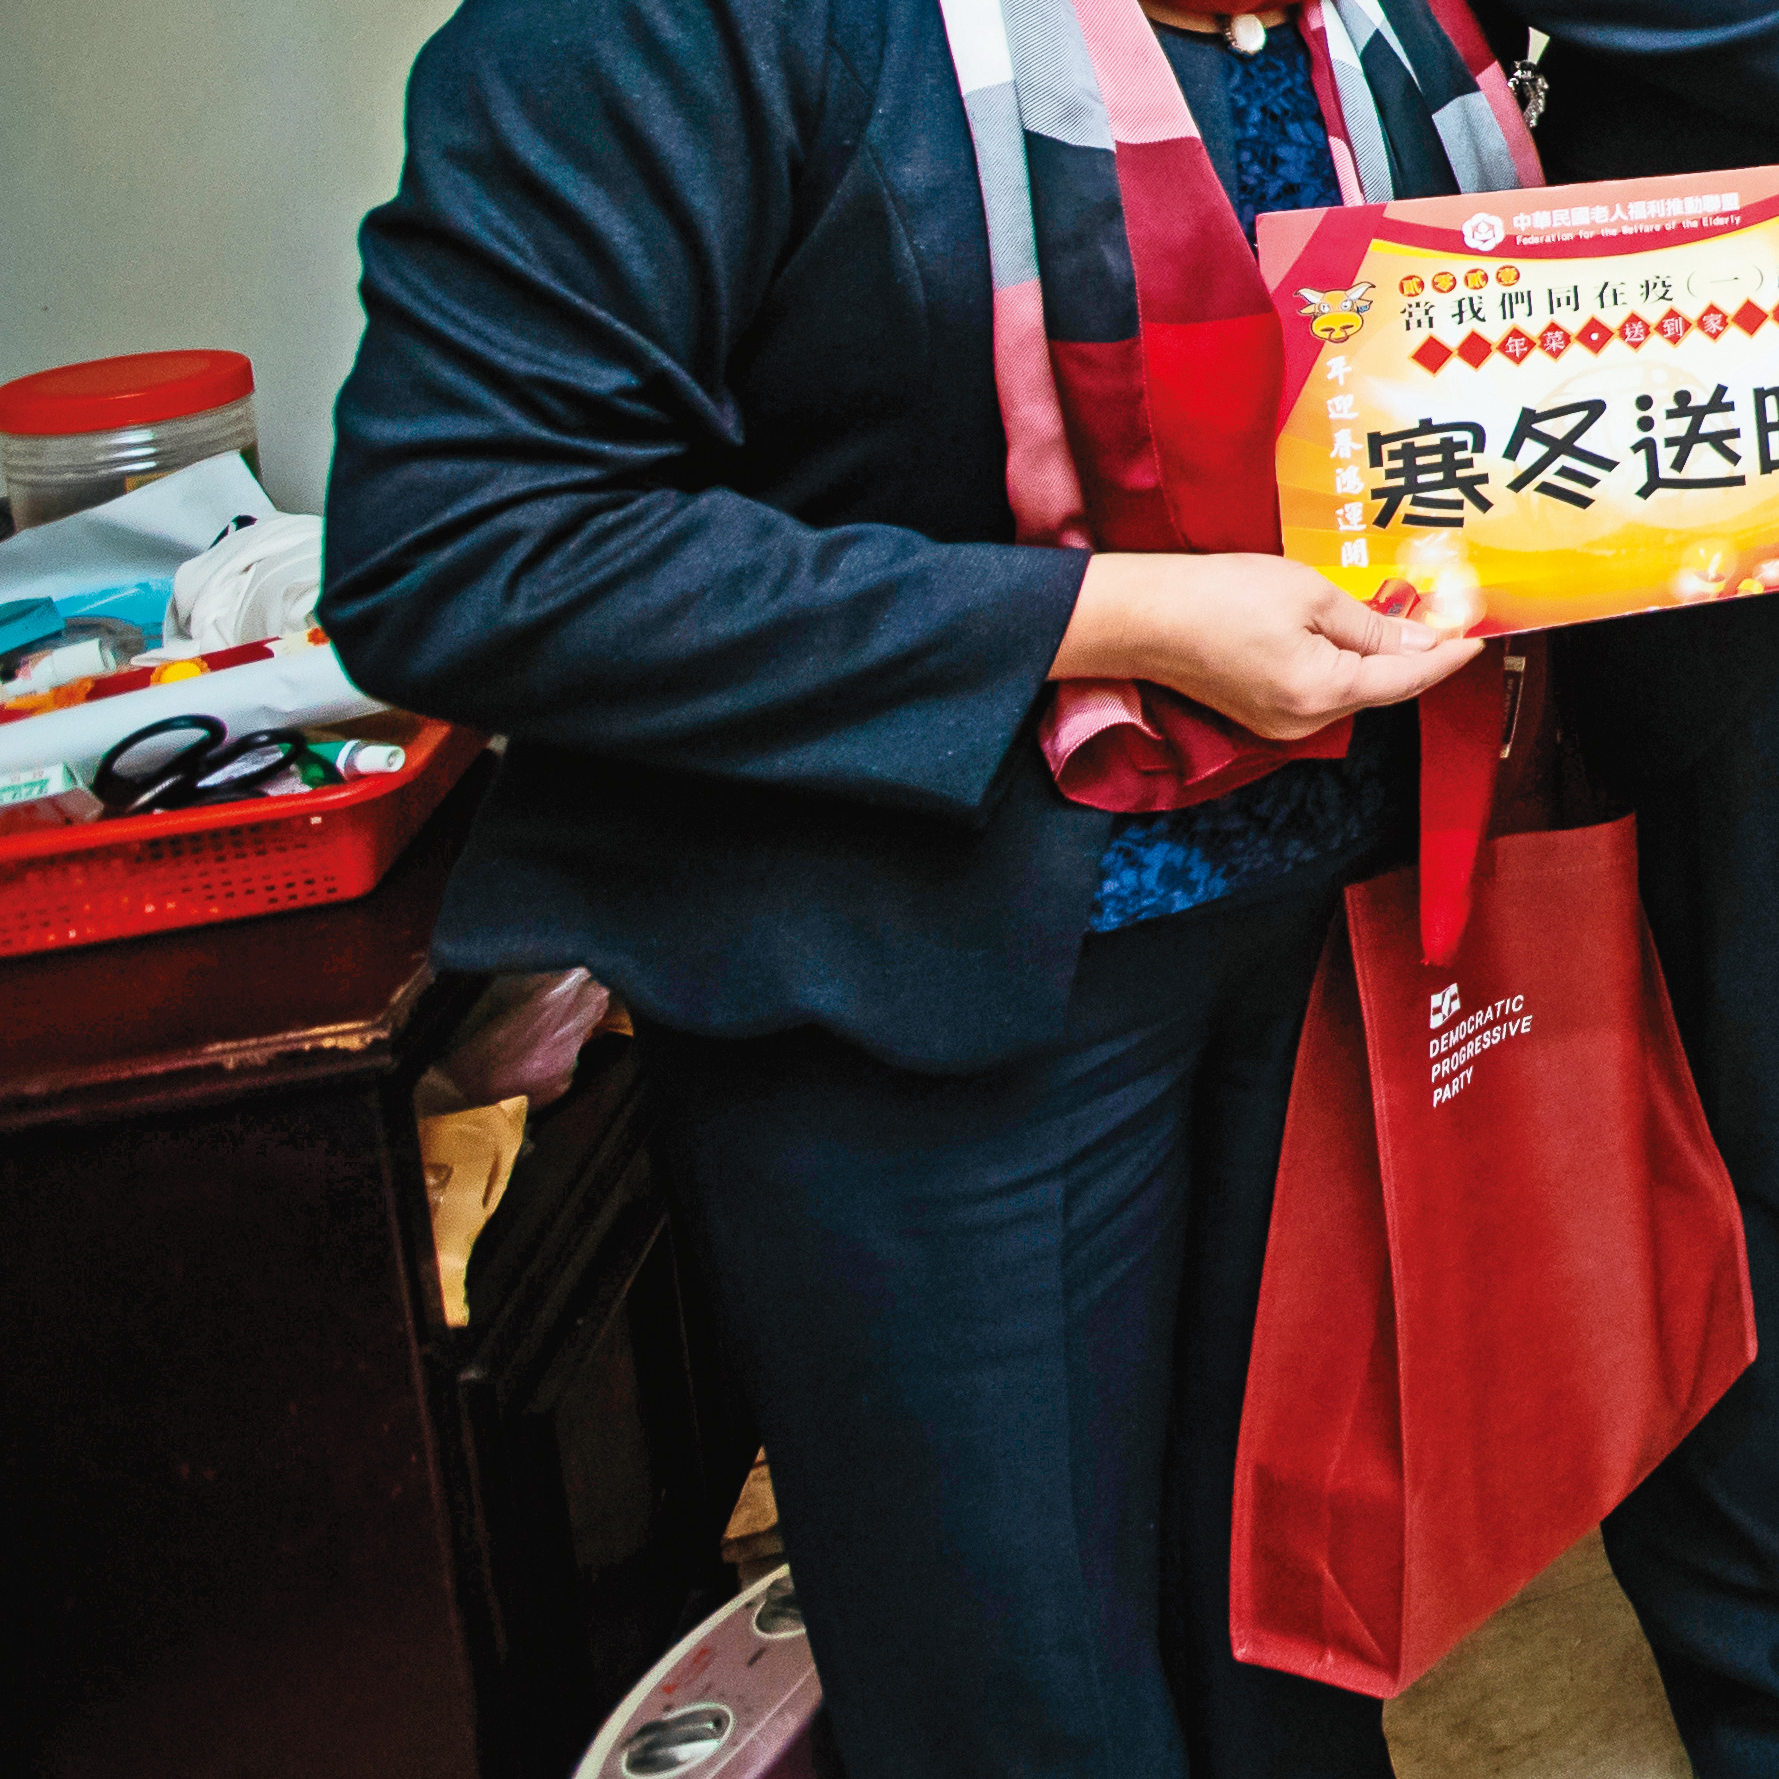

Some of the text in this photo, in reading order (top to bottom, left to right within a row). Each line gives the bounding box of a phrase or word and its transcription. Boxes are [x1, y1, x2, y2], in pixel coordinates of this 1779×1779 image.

[1513, 192, 1741, 232] 中華民國老人福利推動聯盟
[1516, 214, 1741, 246] Federation for the Welfare of the Elderly
[1429, 994, 1525, 1059] DEMOCRATIC
[1431, 1015, 1533, 1083] PROGRESSIVE
[1432, 1066, 1474, 1108] PARTY
